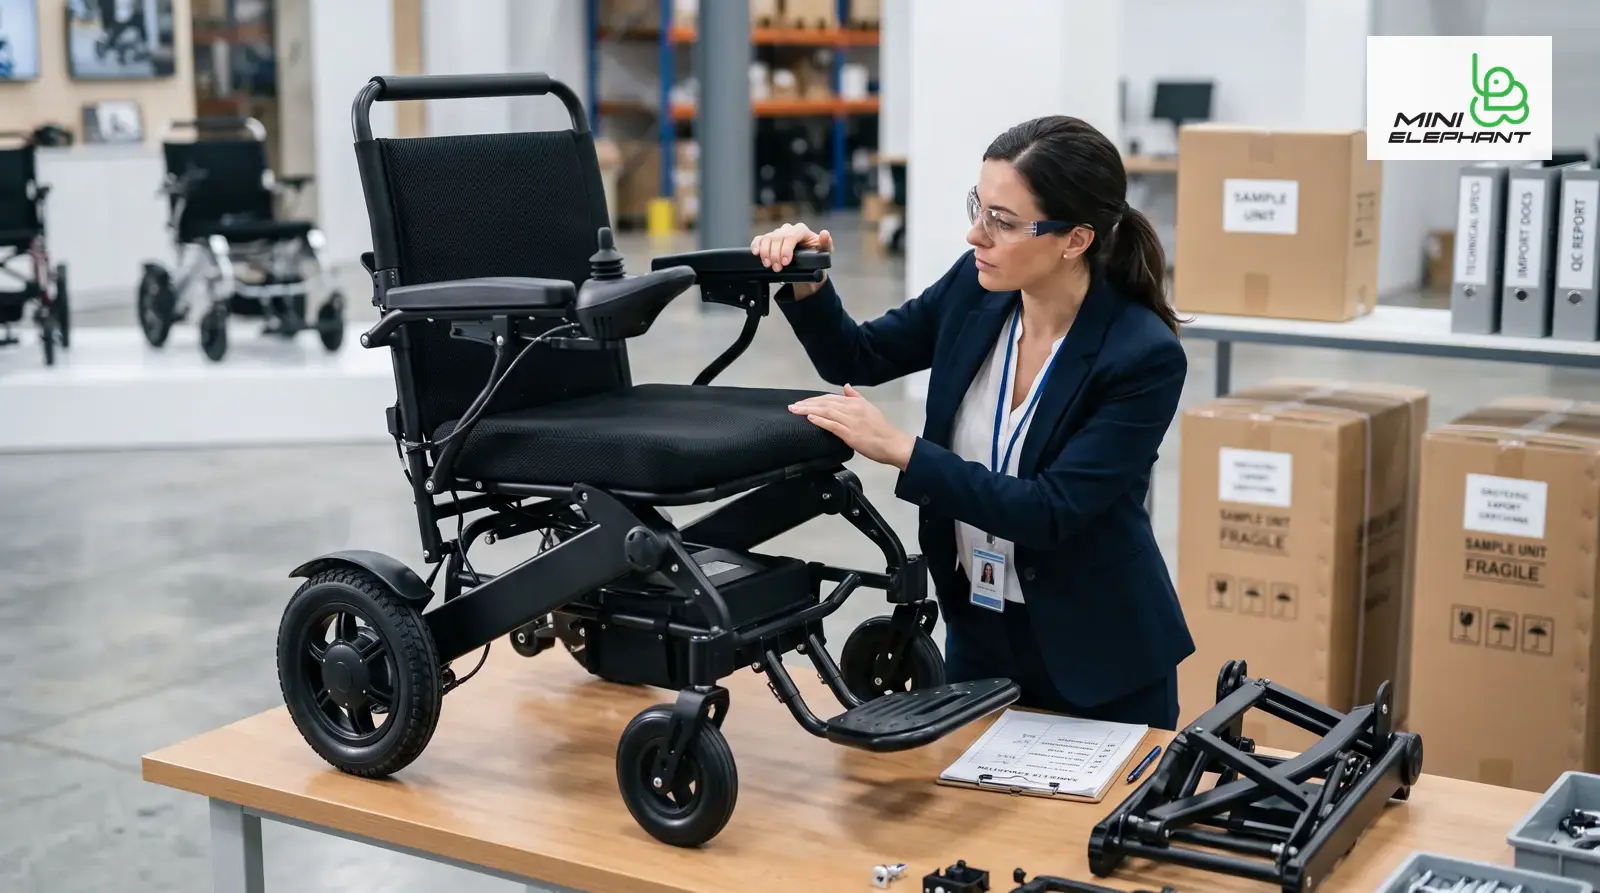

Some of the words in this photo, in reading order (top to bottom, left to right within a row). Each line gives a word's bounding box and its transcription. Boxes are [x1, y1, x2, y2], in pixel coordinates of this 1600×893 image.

[1234, 192, 1287, 205] SAMPLE
[1519, 191, 1533, 226] DOCS
[1243, 209, 1276, 222] UNIT
[1571, 198, 1586, 249] REPORT
[1516, 229, 1530, 279] IMPORT
[1570, 252, 1583, 272] QC
[1220, 506, 1262, 525] SAMPLE
[1266, 513, 1291, 526] UNIT
[1219, 525, 1284, 550] FRAGILE
[1465, 536, 1514, 555] SAMPLE
[1518, 543, 1548, 559] UNIT
[1465, 558, 1540, 583] FRAGILE
